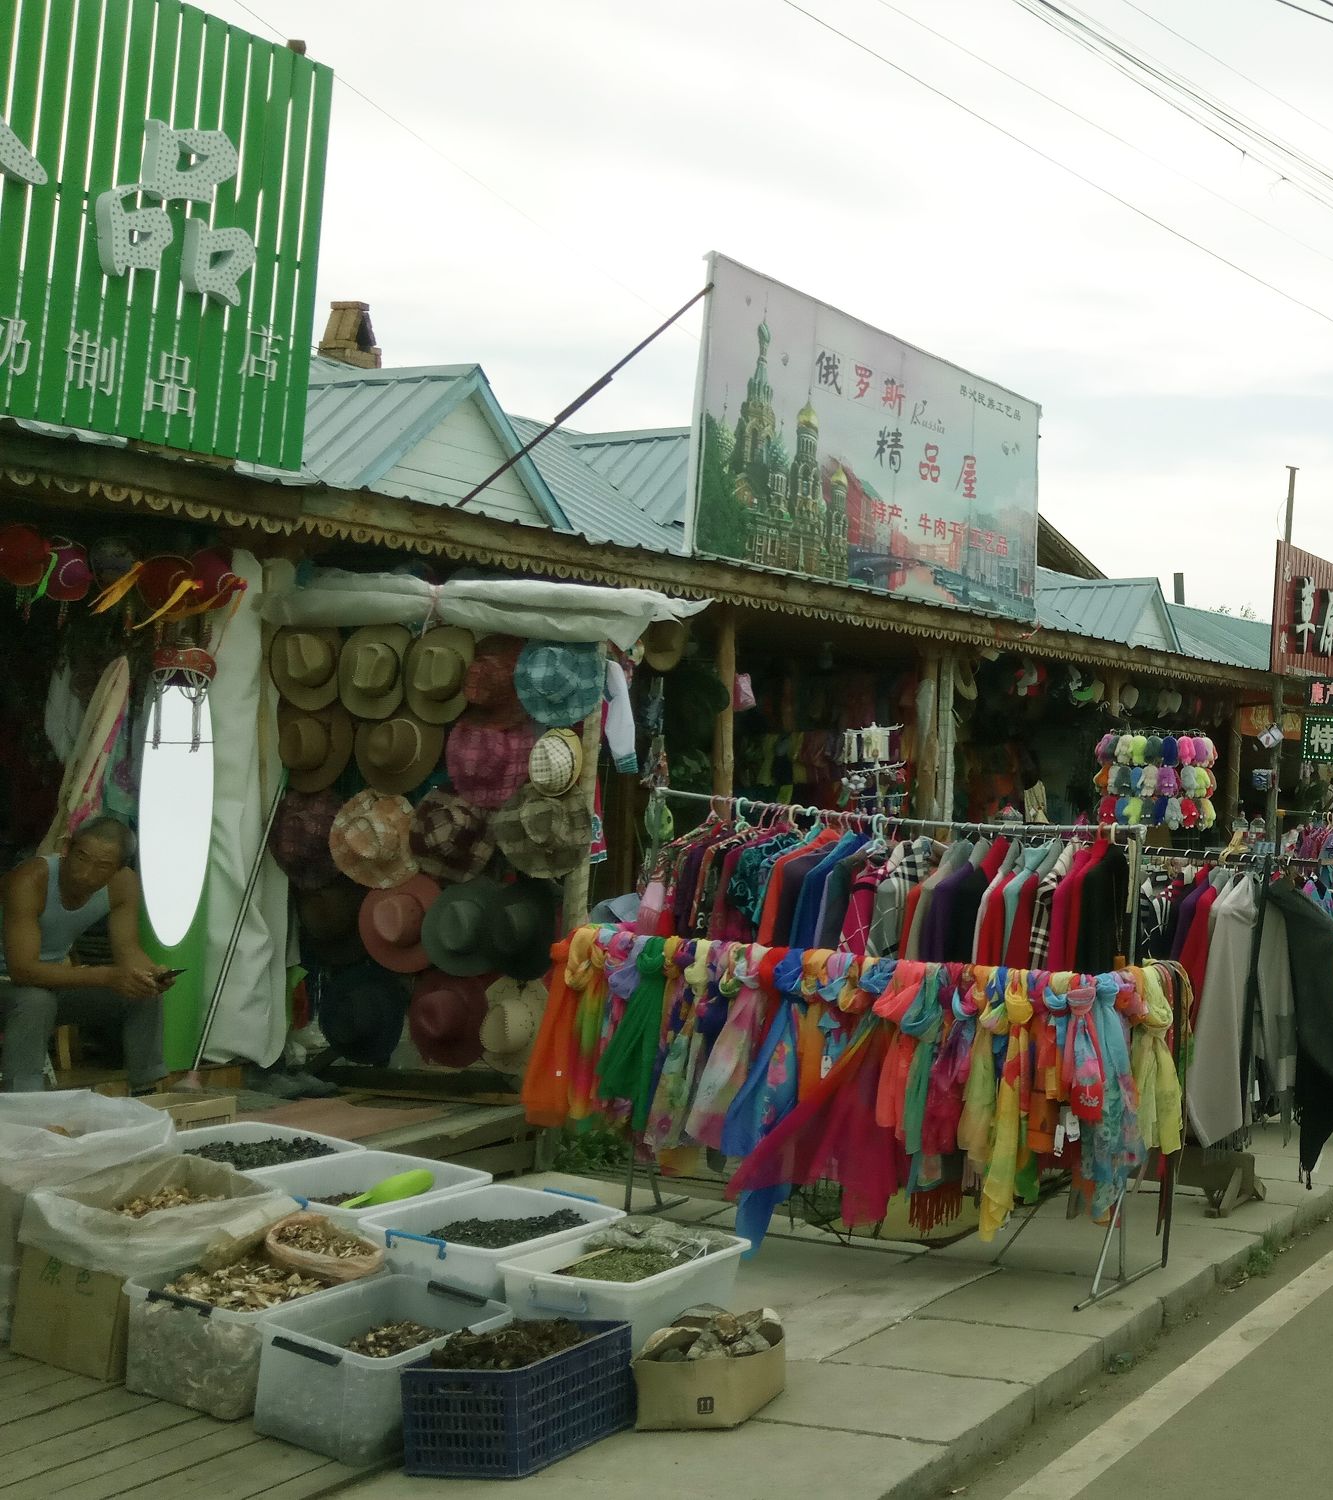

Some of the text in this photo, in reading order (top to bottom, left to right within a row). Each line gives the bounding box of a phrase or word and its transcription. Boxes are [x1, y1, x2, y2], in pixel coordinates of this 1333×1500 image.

[816, 350, 907, 418] 俄罗斯
[910, 399, 945, 435] Russia
[874, 425, 978, 499] 精品屋
[969, 528, 1009, 556] 工艺品
